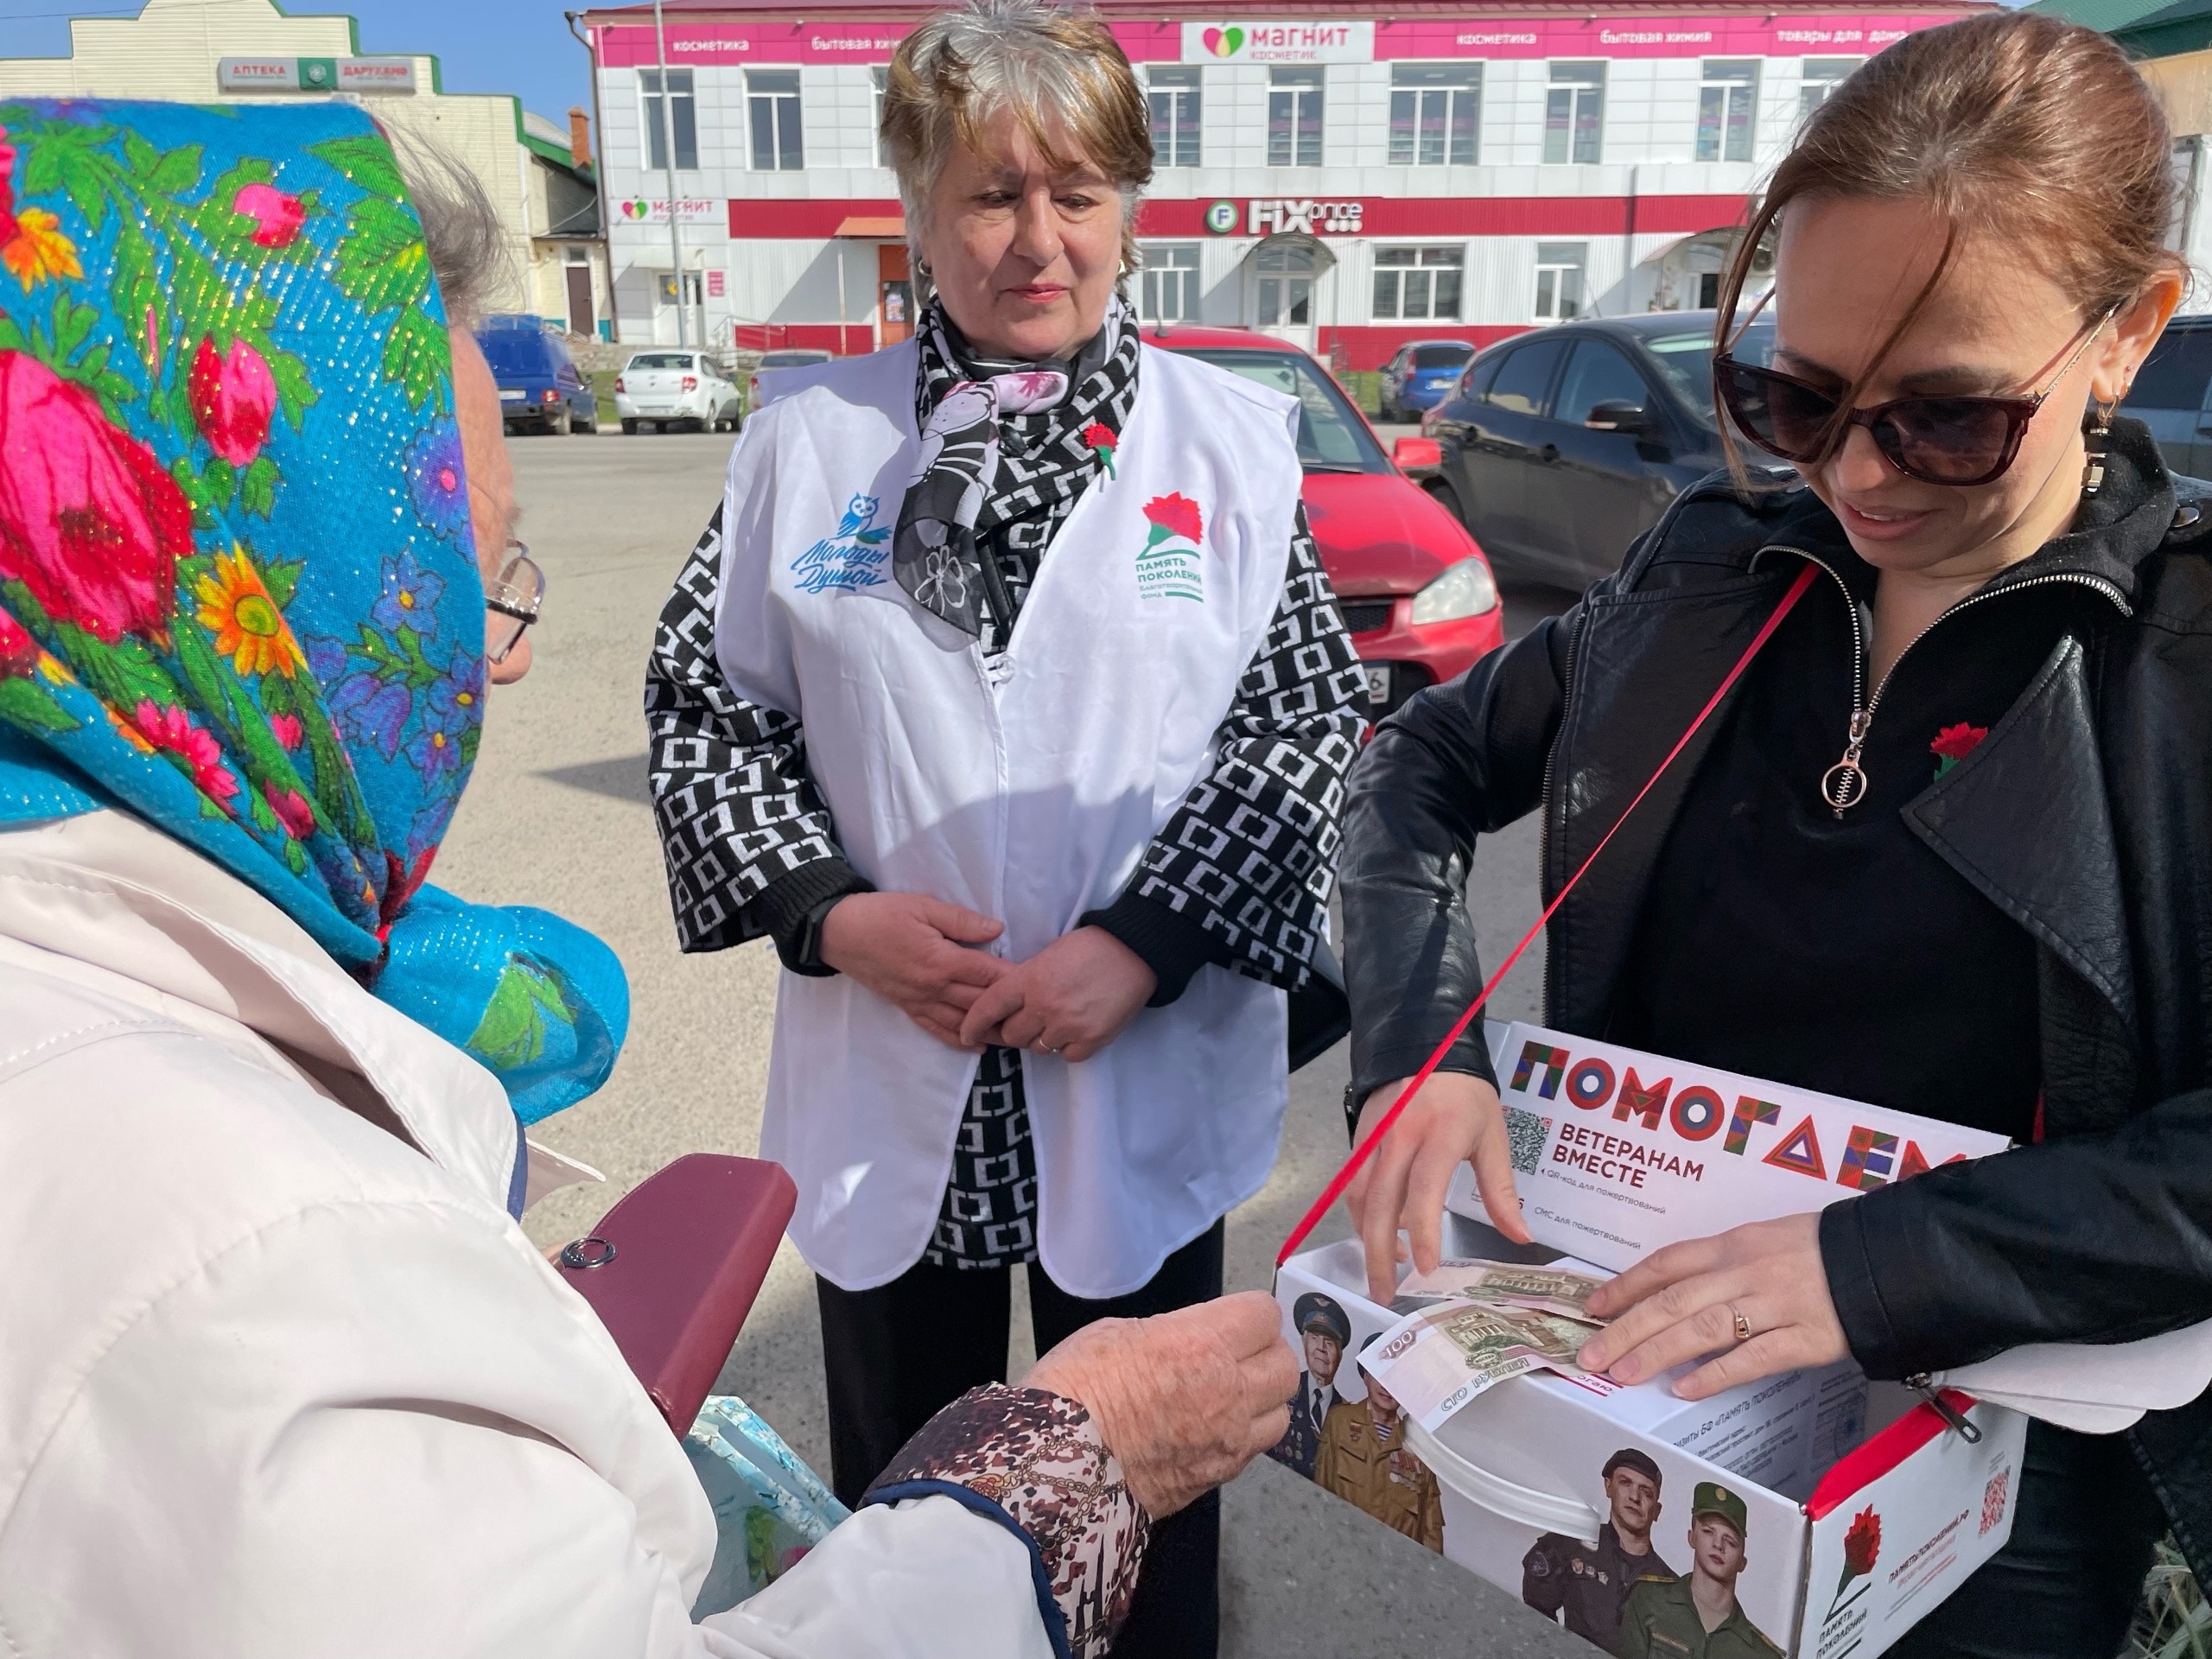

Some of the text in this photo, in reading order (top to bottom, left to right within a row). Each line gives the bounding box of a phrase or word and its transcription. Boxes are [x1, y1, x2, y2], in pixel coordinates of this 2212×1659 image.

[672, 40, 750, 52] косметика
[811, 35, 872, 51] бытовая
[1456, 33, 1537, 45] косметика
[1599, 29, 1663, 44] бытовая
[232, 65, 286, 75] АПТЕКА
[1135, 557, 1186, 572] ПАМЯТЬ
[794, 563, 887, 594] Душой
[1560, 1123, 1705, 1183] ВЕТЕРАНАМ
[1552, 1144, 1647, 1189] ВМЕСТЕ
[1547, 1169, 1667, 1215] QR-код для пожертвований
[1534, 1206, 1642, 1250] СМС для пожертвований
[1384, 1331, 1414, 1359] 100
[1440, 1387, 1467, 1412] СТО
